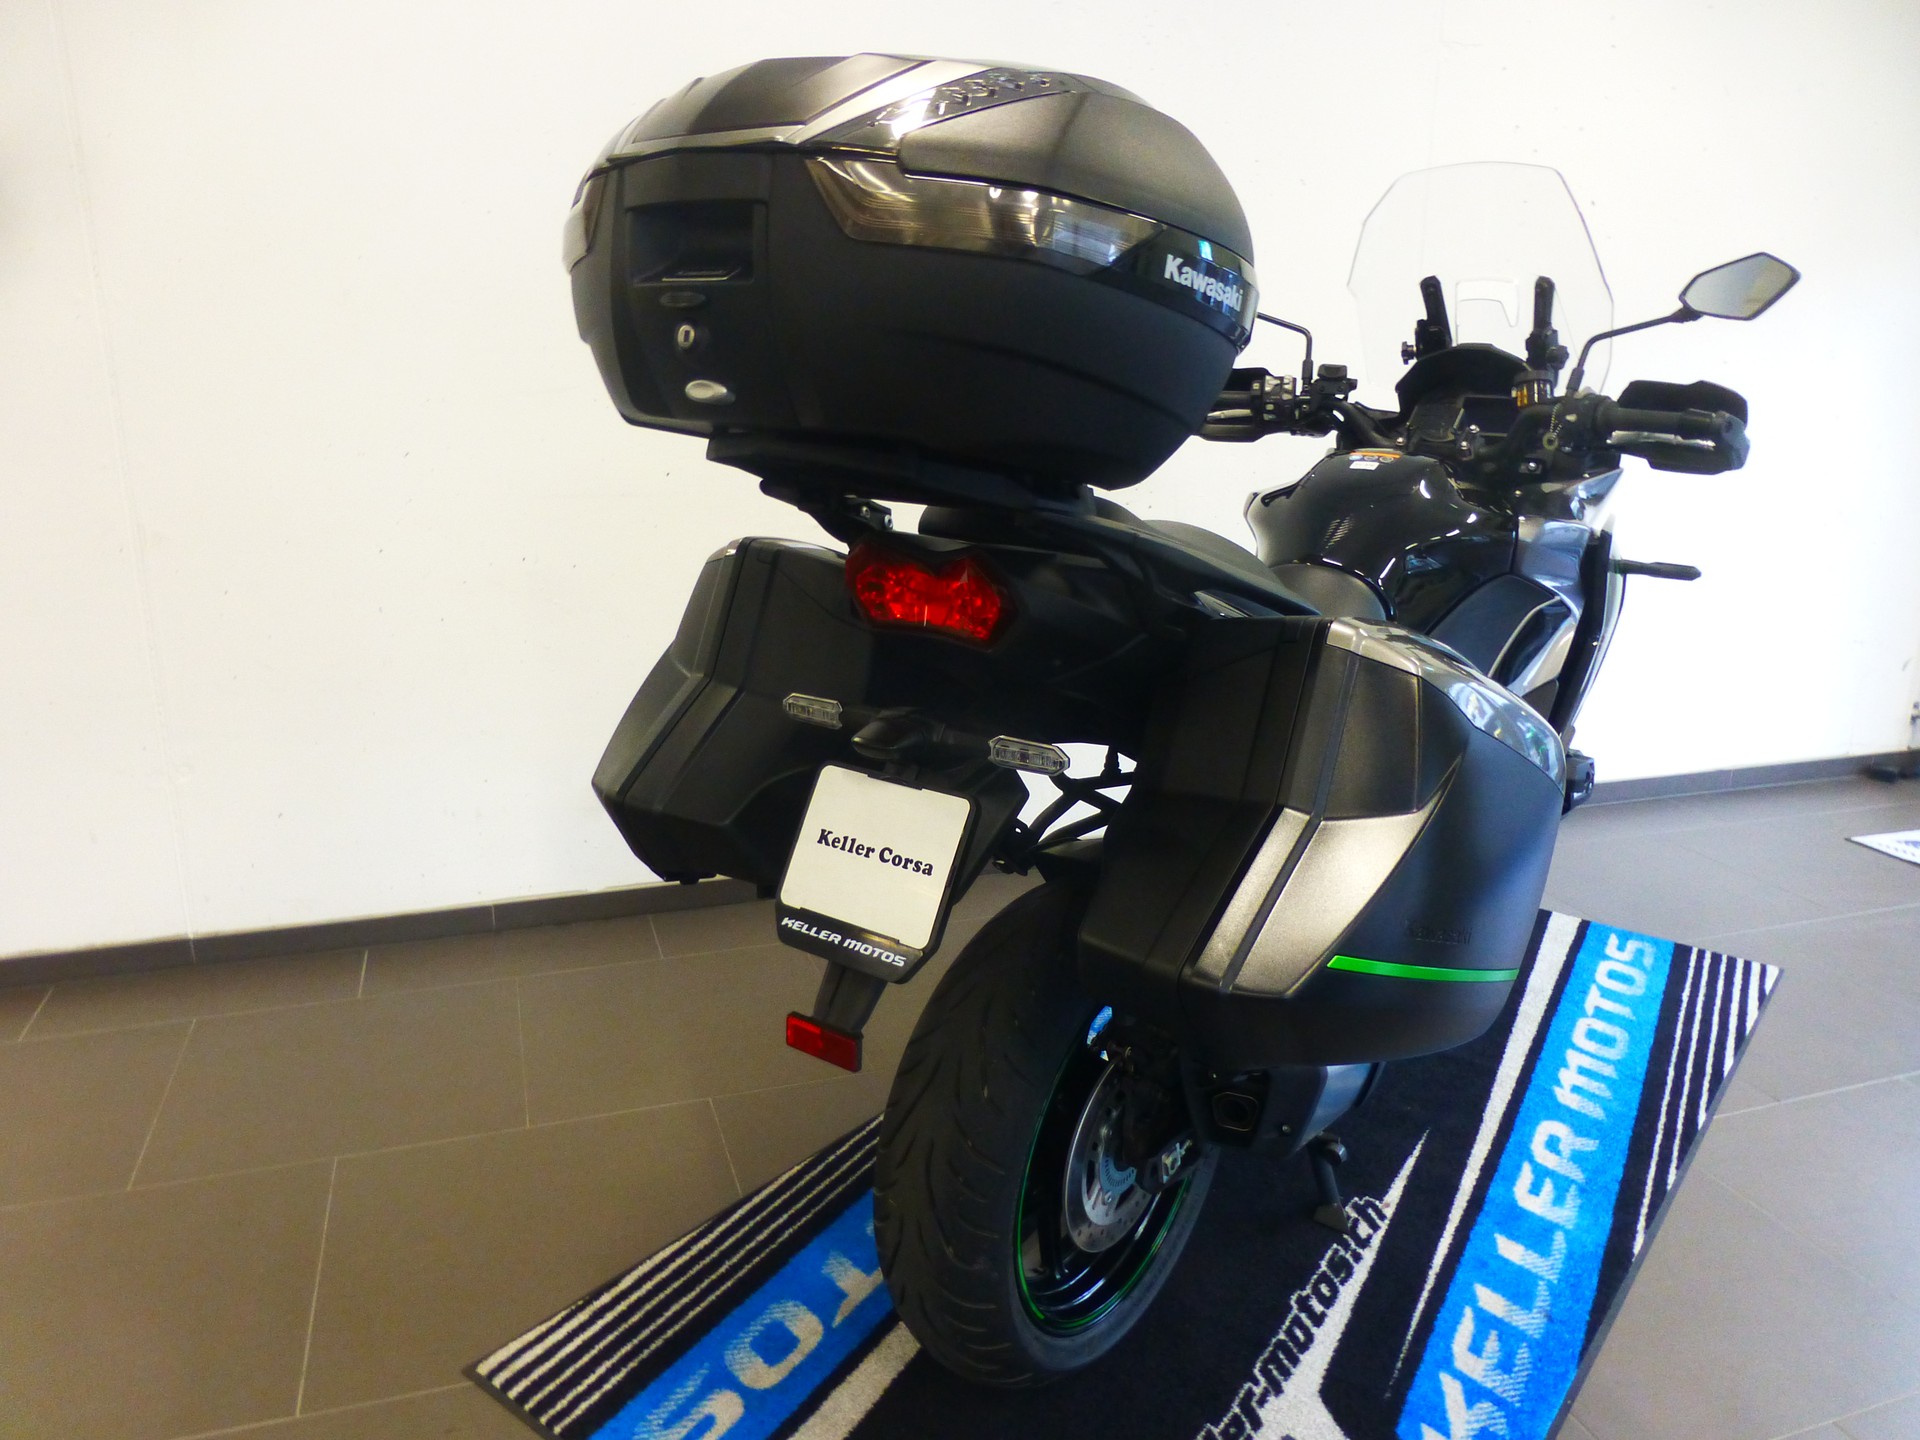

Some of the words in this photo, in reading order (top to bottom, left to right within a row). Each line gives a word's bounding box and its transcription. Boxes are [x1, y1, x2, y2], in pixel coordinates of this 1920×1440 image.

[1164, 254, 1244, 312] Kawasaki
[817, 828, 875, 859] Keller
[878, 847, 934, 877] Corsa
[781, 917, 842, 945] KELLER
[843, 938, 907, 967] MOTOS
[1553, 932, 1656, 1121] MOTOS
